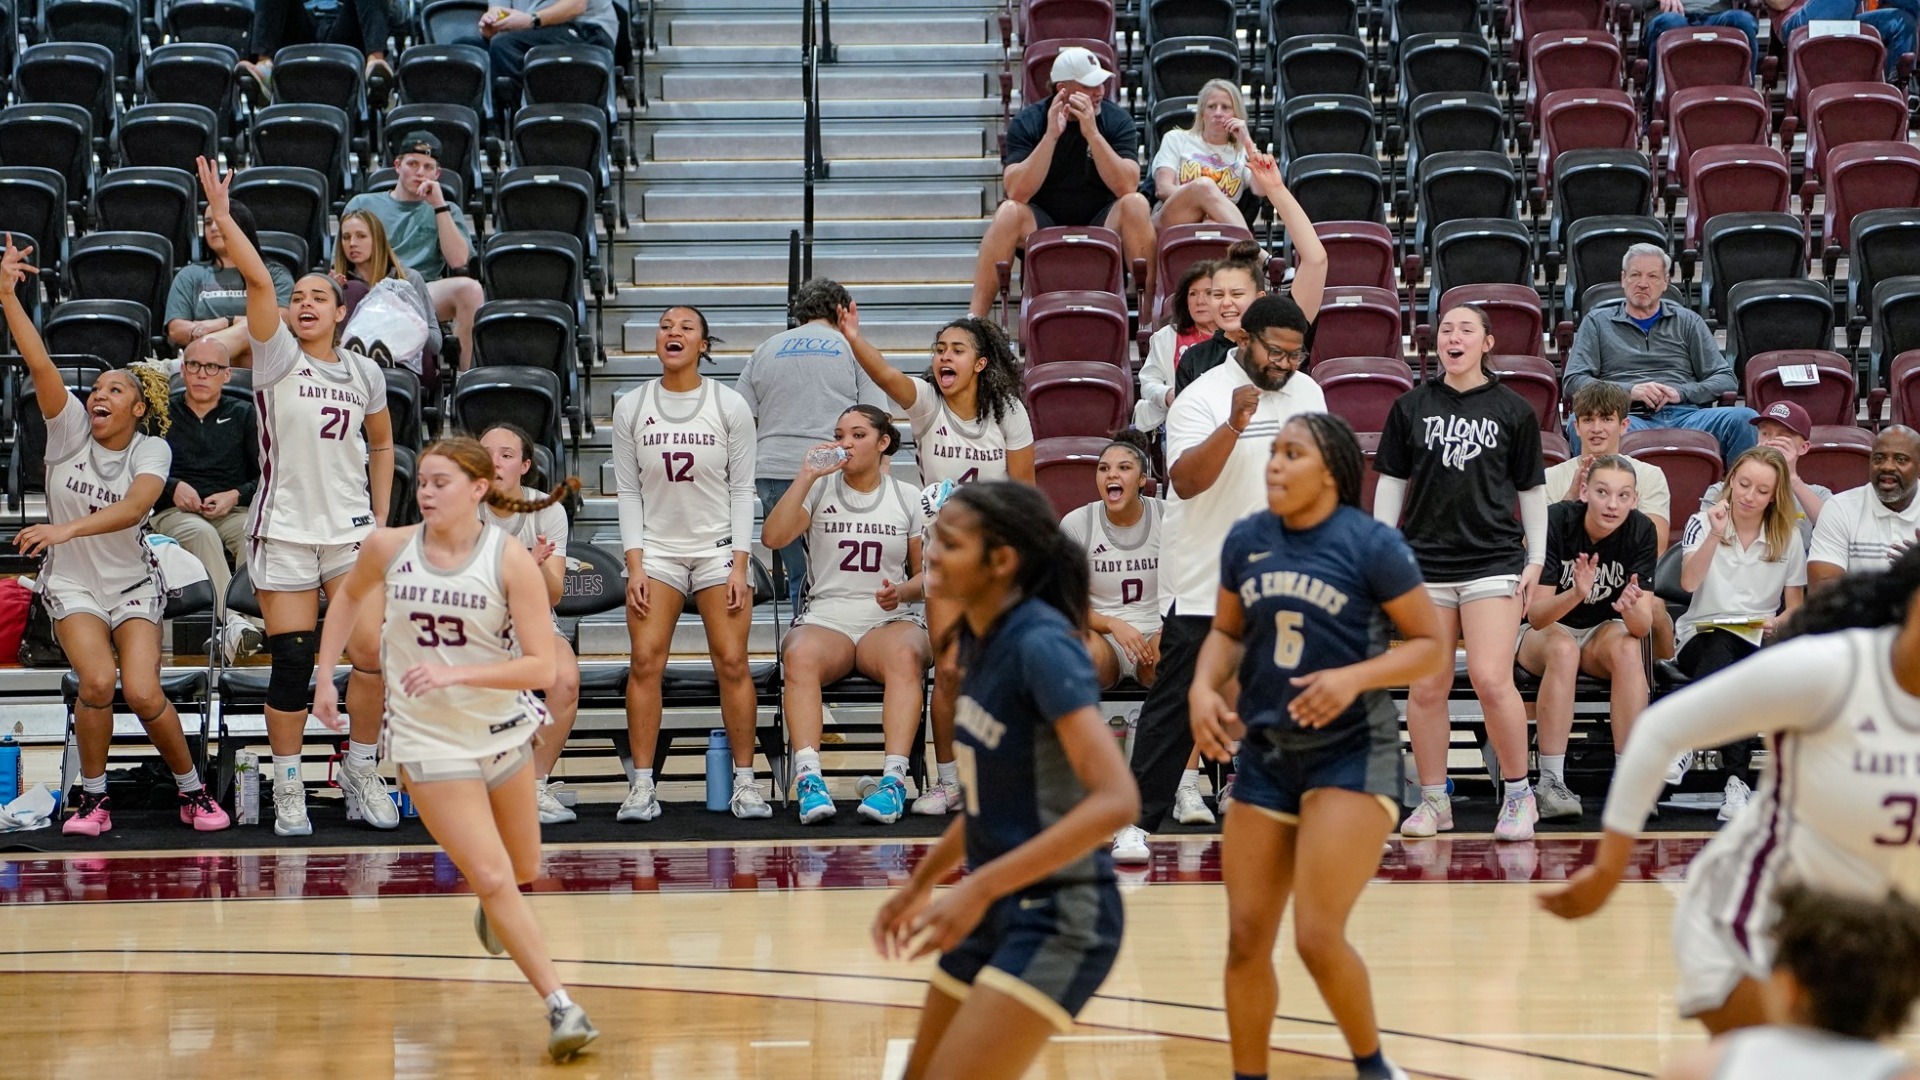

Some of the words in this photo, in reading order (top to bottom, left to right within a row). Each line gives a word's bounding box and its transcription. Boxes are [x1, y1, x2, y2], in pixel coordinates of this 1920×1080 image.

[782, 338, 839, 351] TFCU
[299, 385, 328, 399] LADY
[320, 406, 351, 441] 21
[1422, 414, 1499, 451] TALONS
[643, 433, 669, 446] LADY
[672, 432, 716, 446] EAGLES
[933, 443, 962, 459] LADY
[965, 447, 1004, 461] EAGLES
[661, 451, 695, 483] 12
[1442, 438, 1482, 471] UP
[65, 476, 95, 496] LADY
[824, 522, 852, 533] LADY
[856, 522, 897, 536] EAGLES
[838, 540, 883, 573] 20
[1094, 560, 1122, 573] LADY
[563, 574, 604, 597] GLES
[1560, 559, 1625, 590] TANS
[394, 584, 427, 602] LADY
[431, 588, 488, 610] EAGLES
[1121, 578, 1143, 605] 0
[409, 611, 468, 648] 33
[1273, 609, 1305, 670] 6
[1873, 792, 1920, 847] 3
